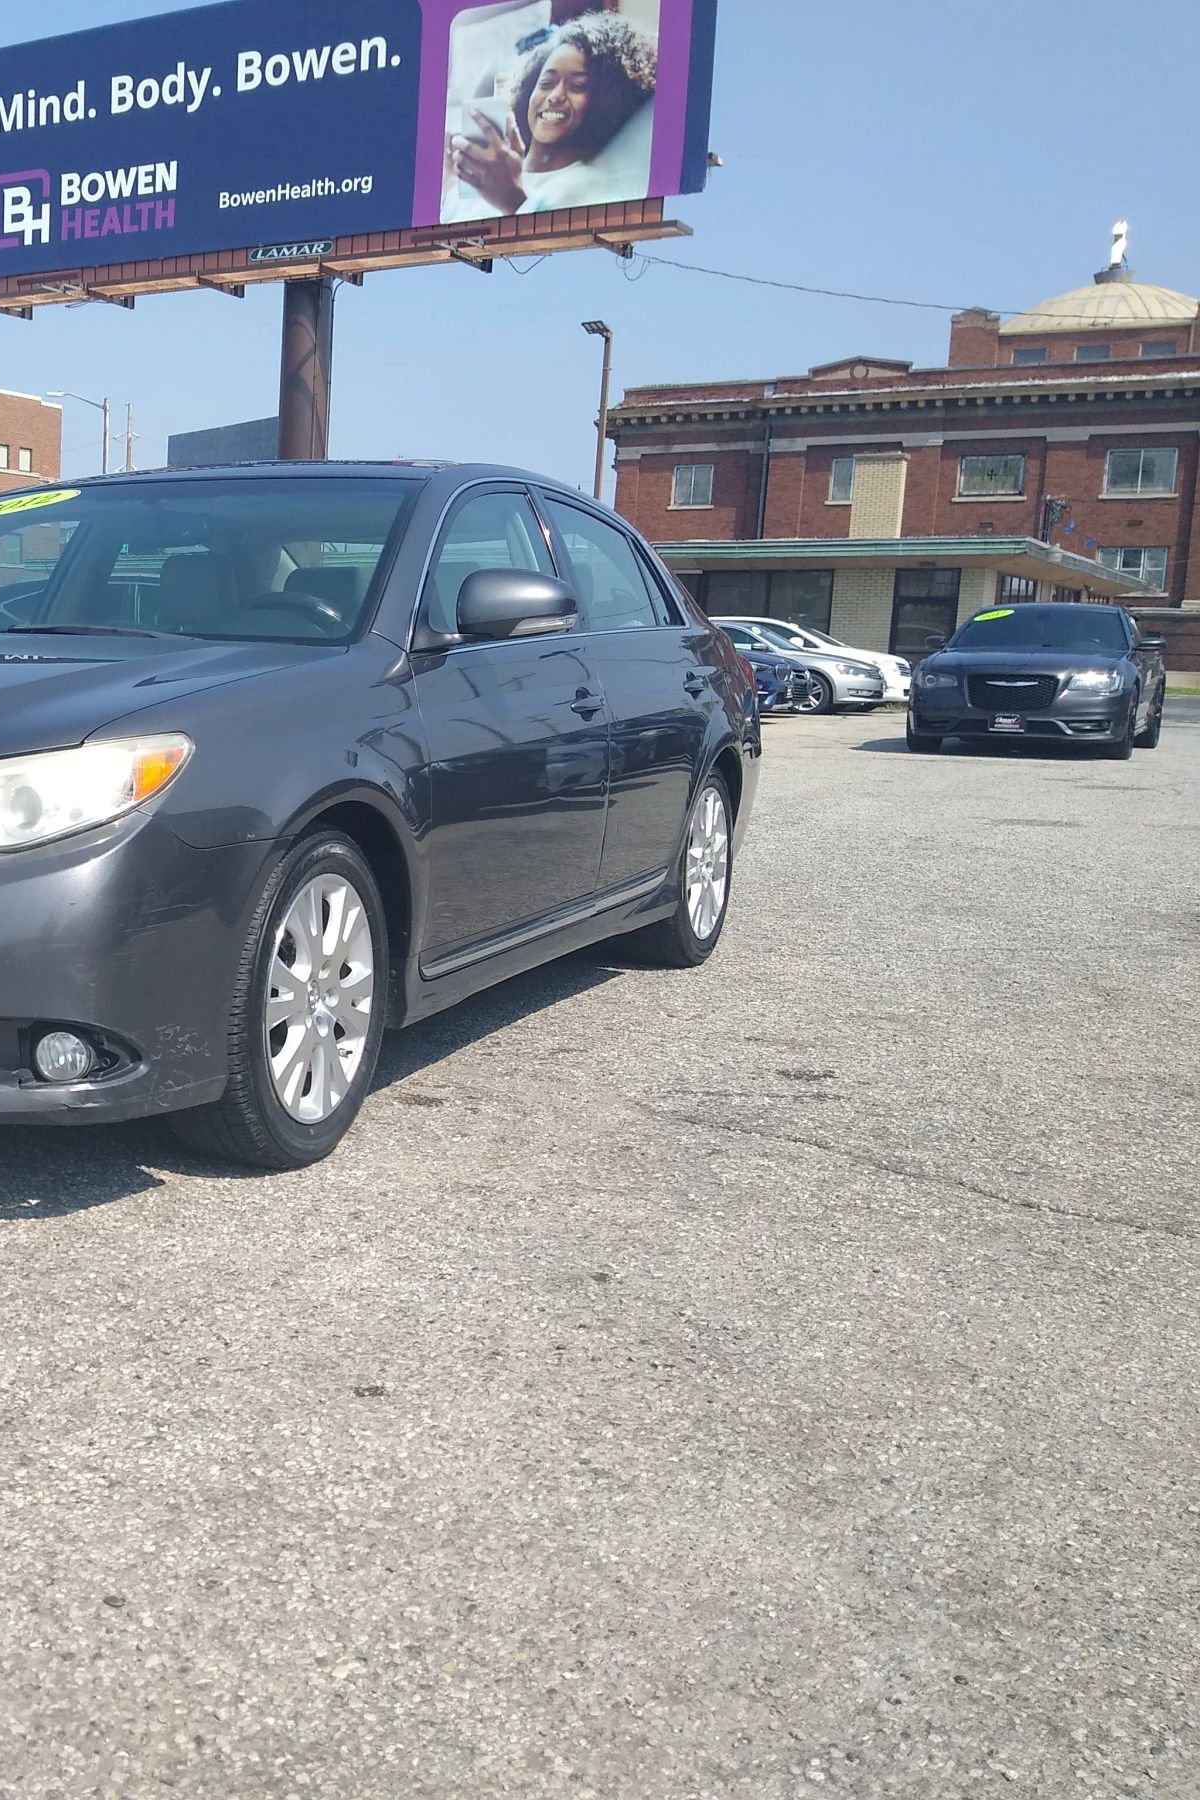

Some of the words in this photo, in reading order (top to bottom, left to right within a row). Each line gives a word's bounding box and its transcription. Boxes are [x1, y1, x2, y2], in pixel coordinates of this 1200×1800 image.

[111, 61, 222, 113] Body.
[237, 36, 401, 92] Bowen.
[61, 160, 178, 206] BOWEN
[219, 175, 373, 209] BowenHealth.org
[3, 186, 50, 246] BH
[61, 198, 175, 241] HEALTH
[256, 243, 325, 259] LAMAR
